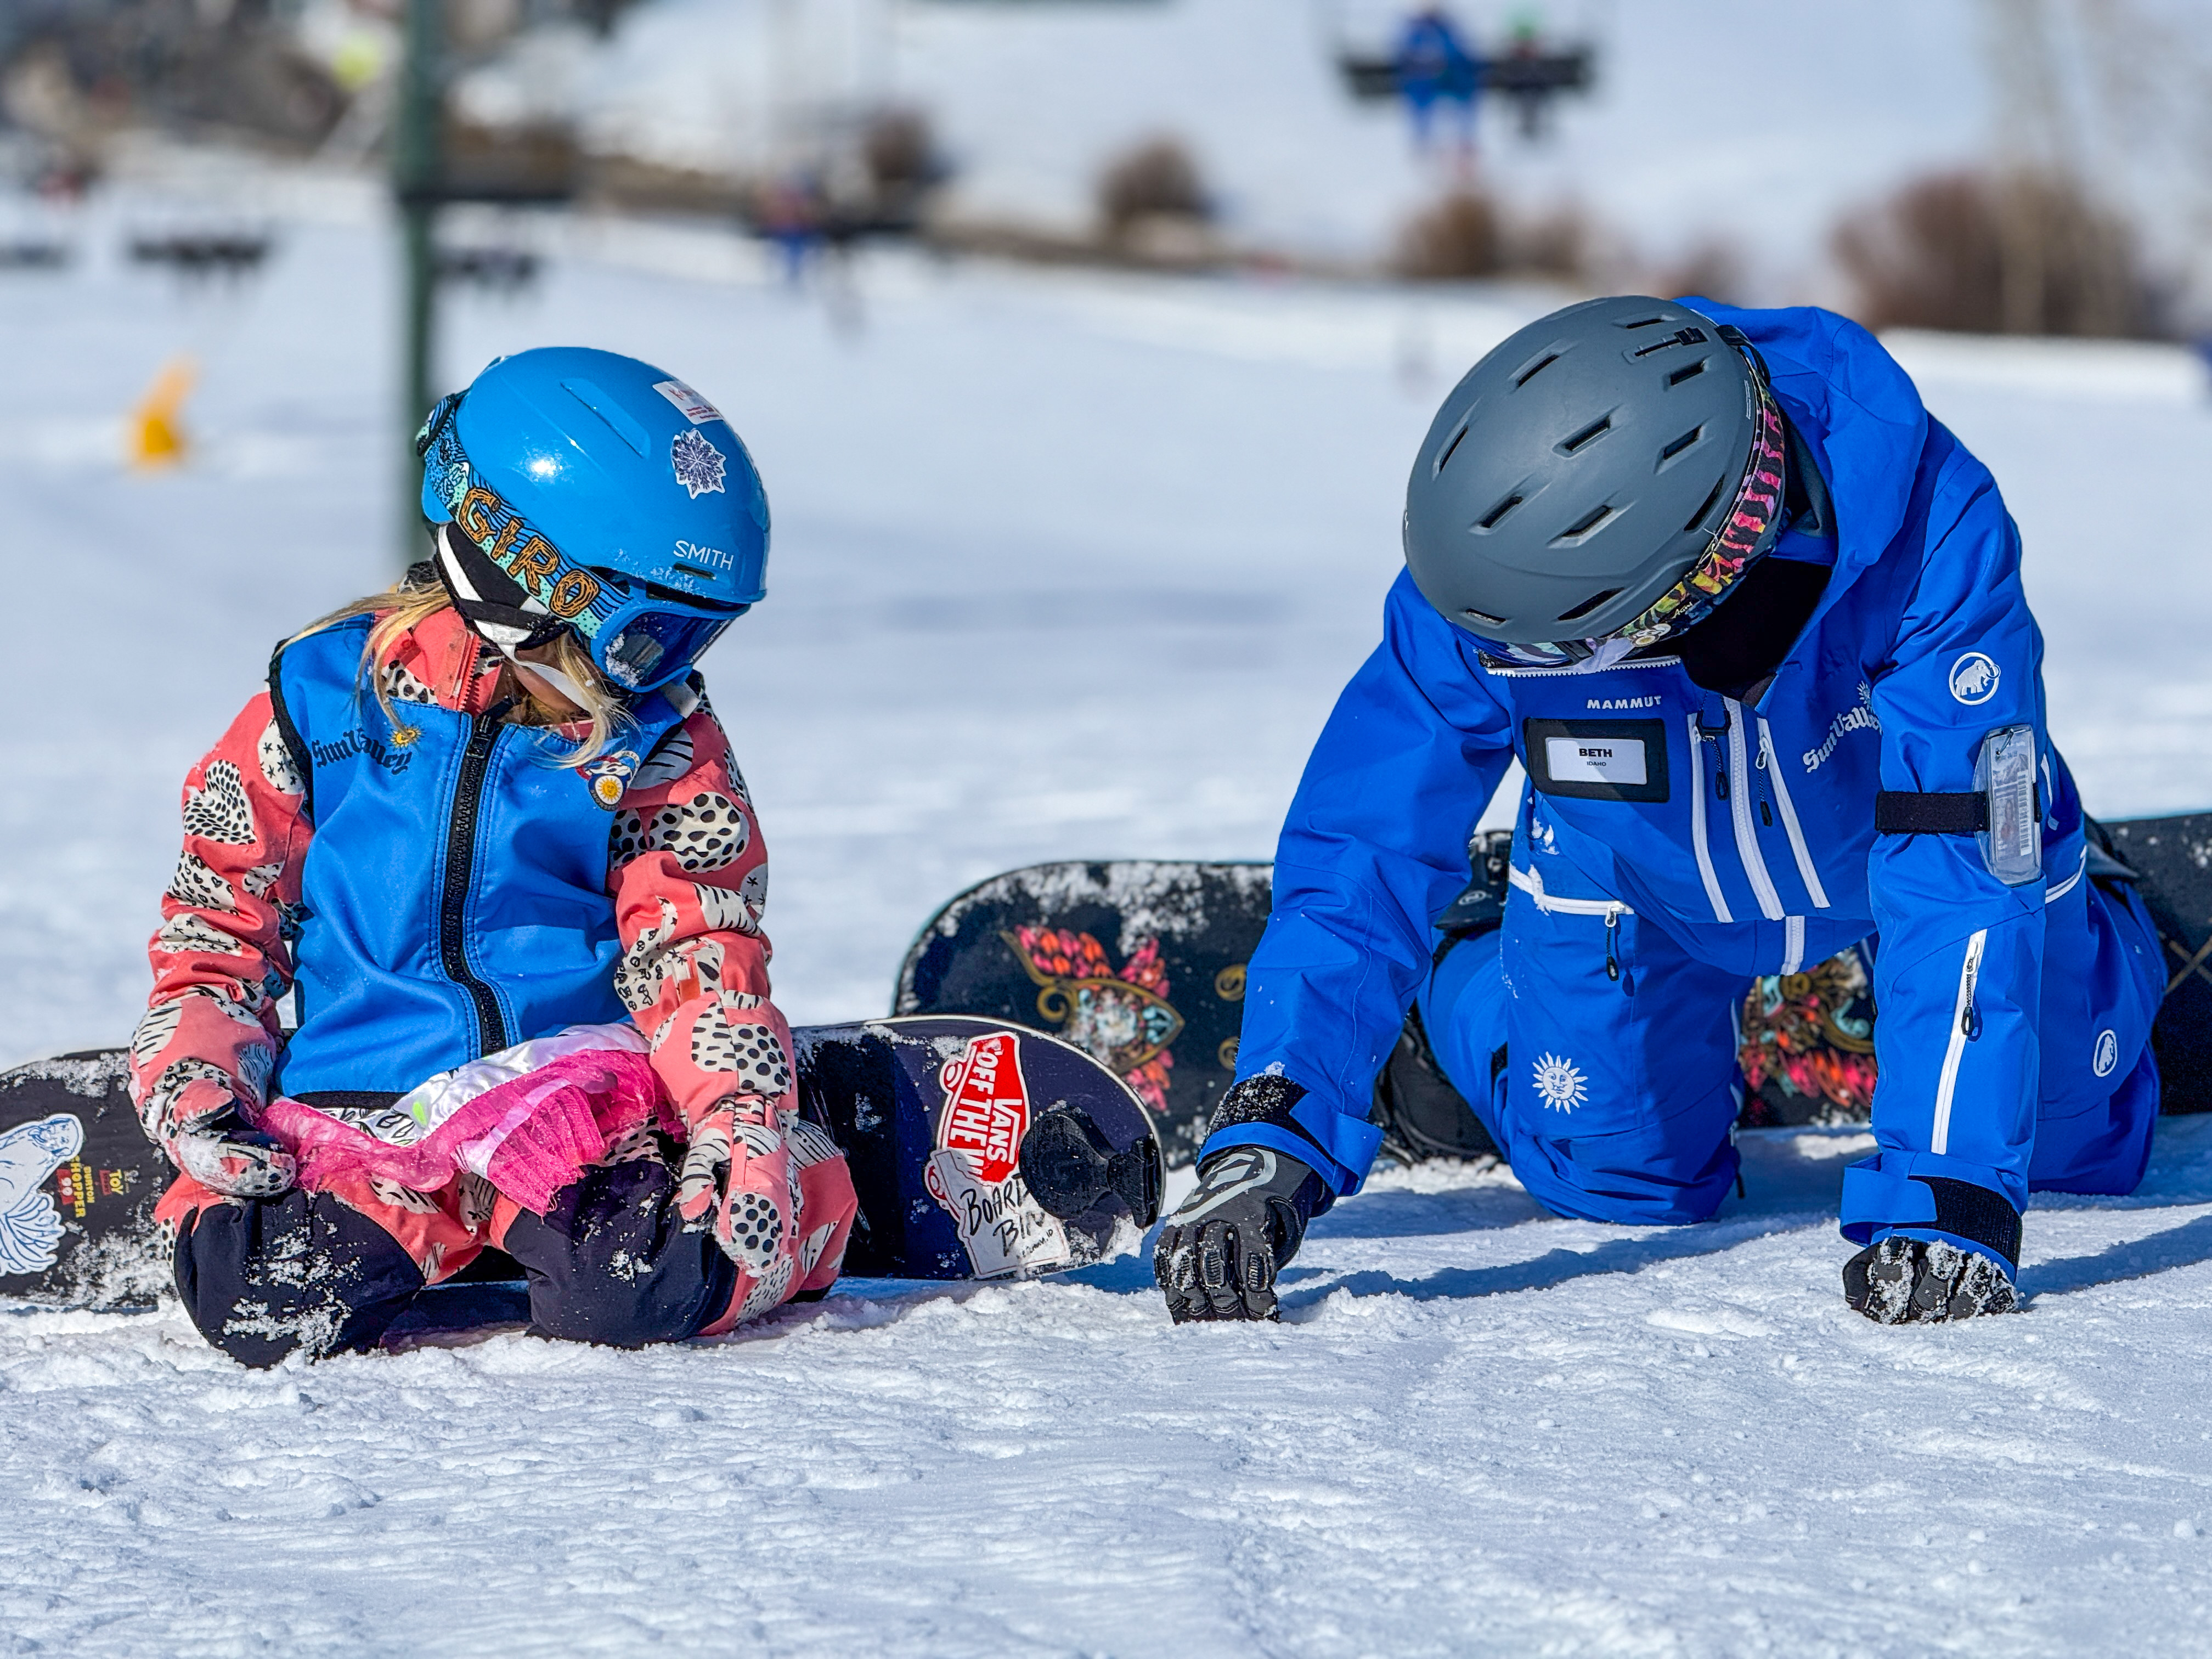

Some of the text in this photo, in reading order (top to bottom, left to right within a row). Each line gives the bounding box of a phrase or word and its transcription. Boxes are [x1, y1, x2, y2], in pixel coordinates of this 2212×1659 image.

[459, 487, 600, 618] GIRO
[673, 540, 734, 571] SMITH
[1587, 695, 1662, 709] MAMMUT
[1579, 748, 1613, 758] BETH
[950, 1098, 992, 1147] THE
[986, 1098, 1023, 1164] VANS
[83, 1166, 95, 1204] BURTON
[109, 1169, 124, 1196] TOY
